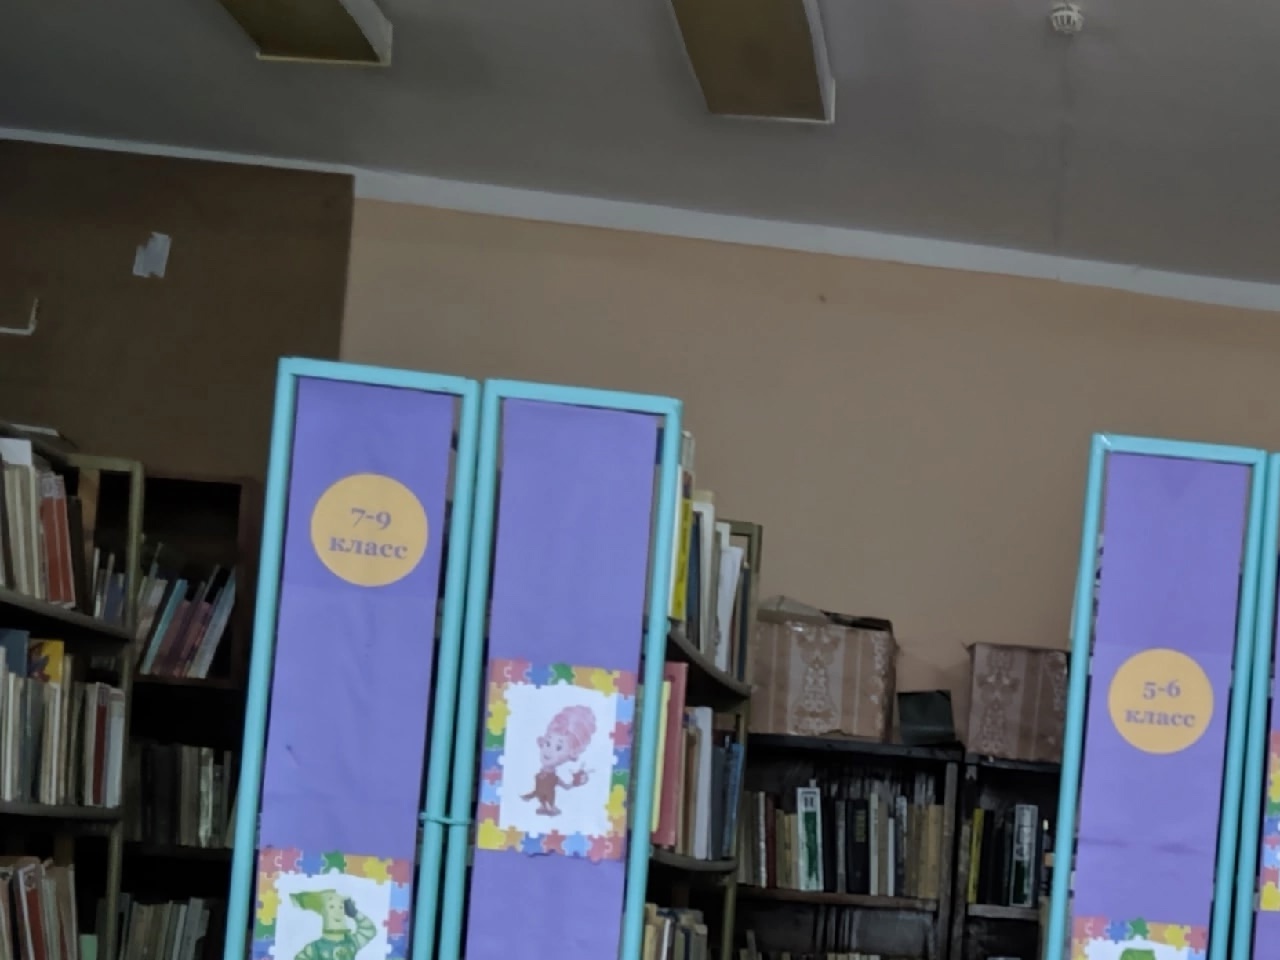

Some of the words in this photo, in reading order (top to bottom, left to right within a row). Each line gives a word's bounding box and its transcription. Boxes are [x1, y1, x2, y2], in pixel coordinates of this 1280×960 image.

[350, 507, 392, 530] 7-9
[328, 535, 409, 560] класс
[1143, 679, 1182, 700] 5-6
[1124, 708, 1197, 728] класс
